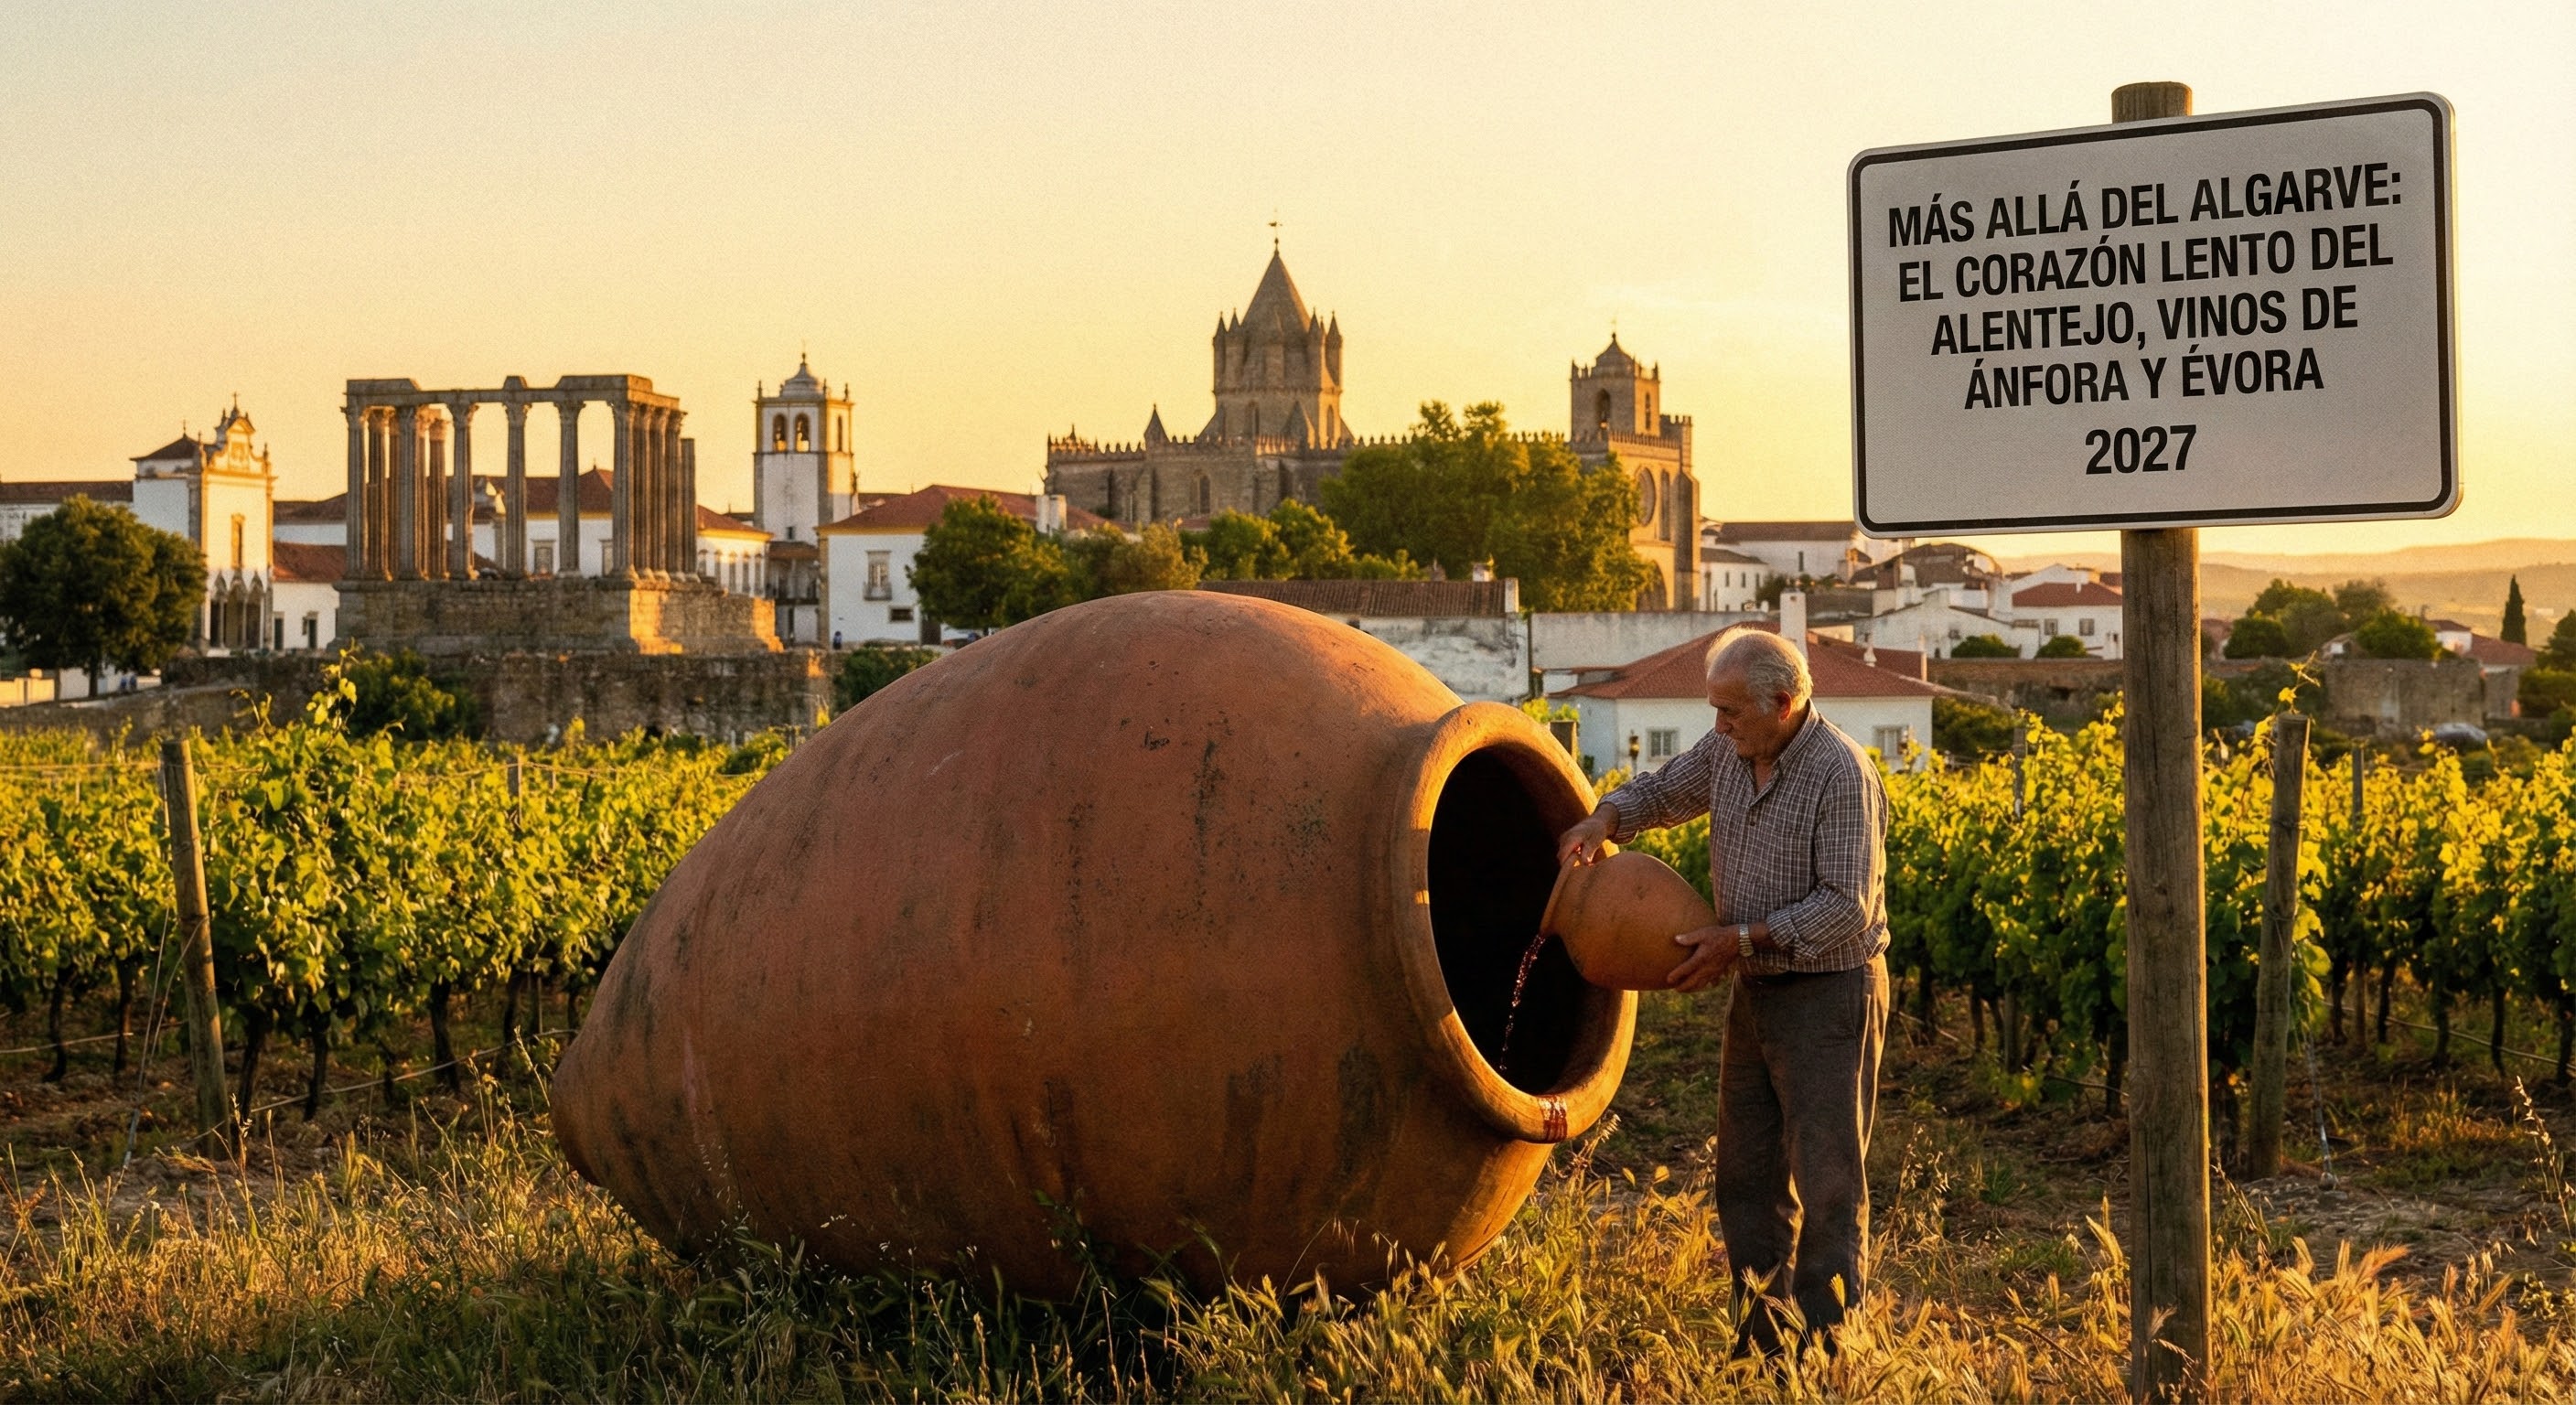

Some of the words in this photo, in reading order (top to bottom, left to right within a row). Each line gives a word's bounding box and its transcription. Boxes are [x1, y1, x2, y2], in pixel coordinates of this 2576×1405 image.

[1888, 192, 1975, 248] MÁS
[1985, 179, 2089, 240] ALLÁ
[2101, 182, 2179, 230] DEL
[2189, 162, 2401, 222] ALGARVE:
[1899, 260, 1944, 303] EL
[1955, 234, 2146, 298] CORAZÓN
[2161, 230, 2295, 283] LENTO
[2311, 222, 2394, 271] DEL
[1930, 301, 2146, 356] ALENTEJO,
[2156, 290, 2287, 340] VINOS
[2302, 284, 2358, 331] DE
[1964, 357, 2131, 410] ÁNFORA
[2140, 357, 2168, 399] Y
[2181, 343, 2325, 398] ÉVORA
[2085, 424, 2197, 476] 2027
